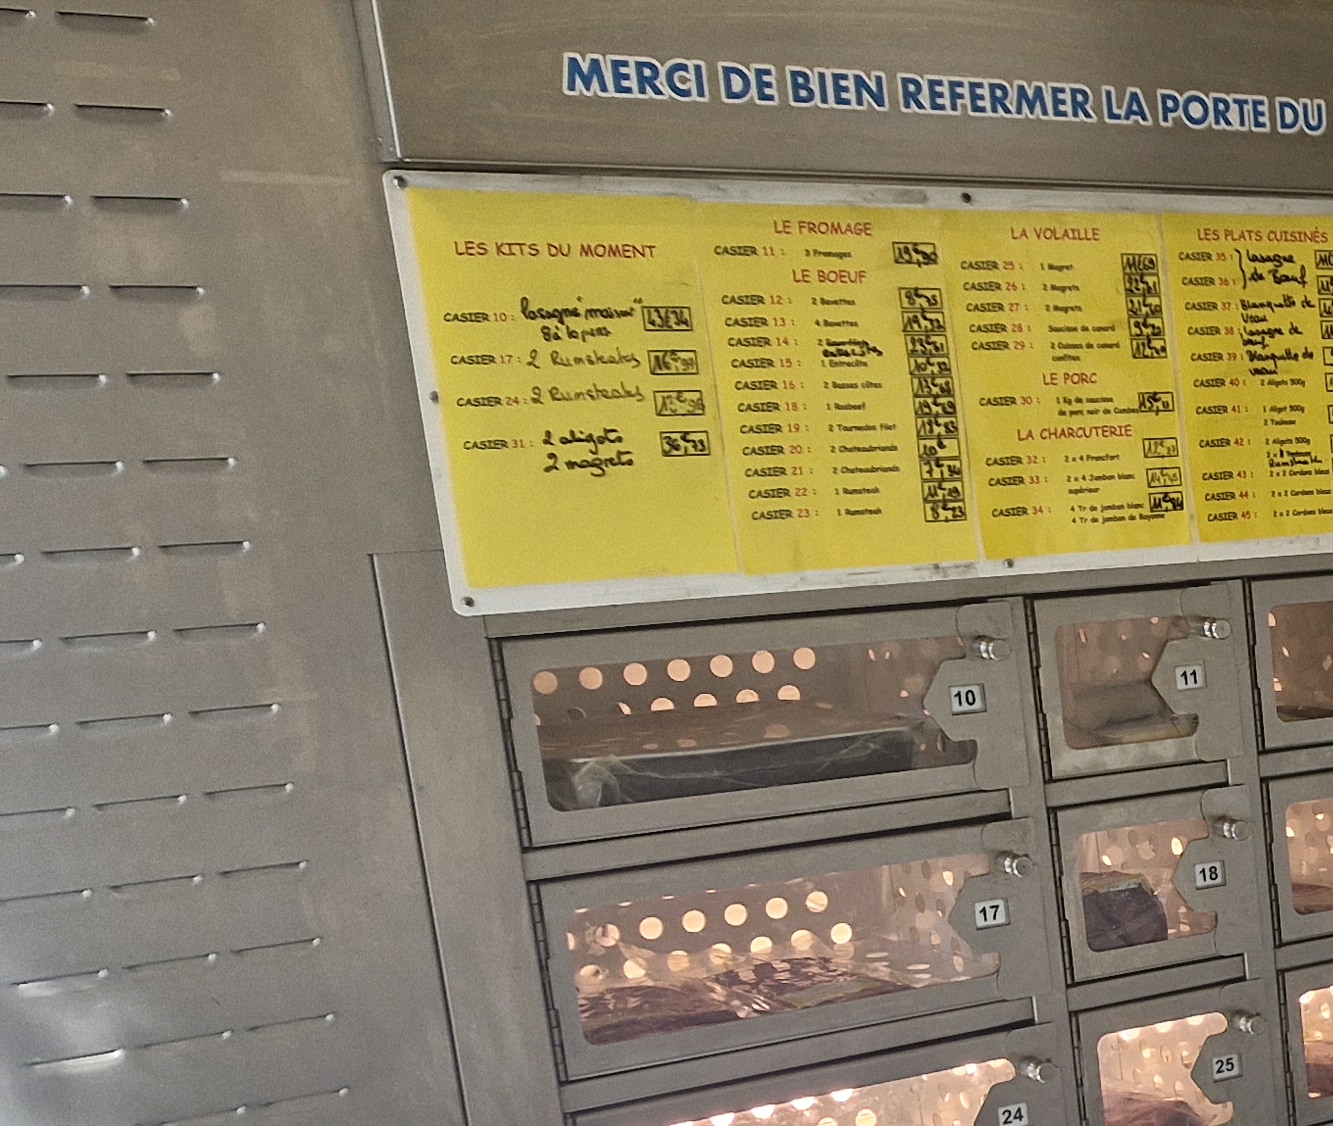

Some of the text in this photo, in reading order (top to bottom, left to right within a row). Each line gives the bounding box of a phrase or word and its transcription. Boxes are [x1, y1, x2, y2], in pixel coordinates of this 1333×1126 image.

[565, 55, 707, 100] MERCI
[719, 65, 776, 104] DE
[790, 68, 885, 110] BIEN
[898, 74, 1095, 120] REFERMER
[1103, 87, 1150, 124] LA
[1160, 89, 1267, 131] PORTE
[1278, 96, 1325, 134] DU
[774, 220, 871, 236] LE FROMAGE
[1011, 228, 1099, 241] LA VOLAILLE
[1198, 227, 1328, 243] LES PLATS CUISINÉS
[455, 241, 655, 258] LES KITS DU MOMENT
[714, 246, 775, 256] CASIER 11
[1179, 252, 1226, 261] CASIER 35
[961, 261, 1014, 270] CASIER 25
[793, 269, 865, 283] LE BOEUF
[444, 312, 507, 323] CASIER 10
[451, 355, 513, 365] CASIER 17
[526, 349, 541, 369] 2
[1043, 373, 1096, 385] LE PORC
[457, 396, 520, 407] CASIER 24
[531, 385, 544, 405] 2
[980, 396, 1033, 406] CASIER 30
[738, 402, 798, 412] CASIER 18
[542, 430, 554, 446] 2
[1018, 424, 1131, 441] LA CHARCUTERIE
[464, 439, 524, 450] CASIER 31
[542, 453, 559, 473] 2
[752, 509, 810, 520] CASIER 23
[1181, 670, 1197, 685] 11
[954, 690, 976, 706] 10
[1200, 866, 1218, 882] 18
[980, 905, 999, 922] 17
[1216, 1058, 1234, 1074] 25
[1002, 1107, 1024, 1125] 24
